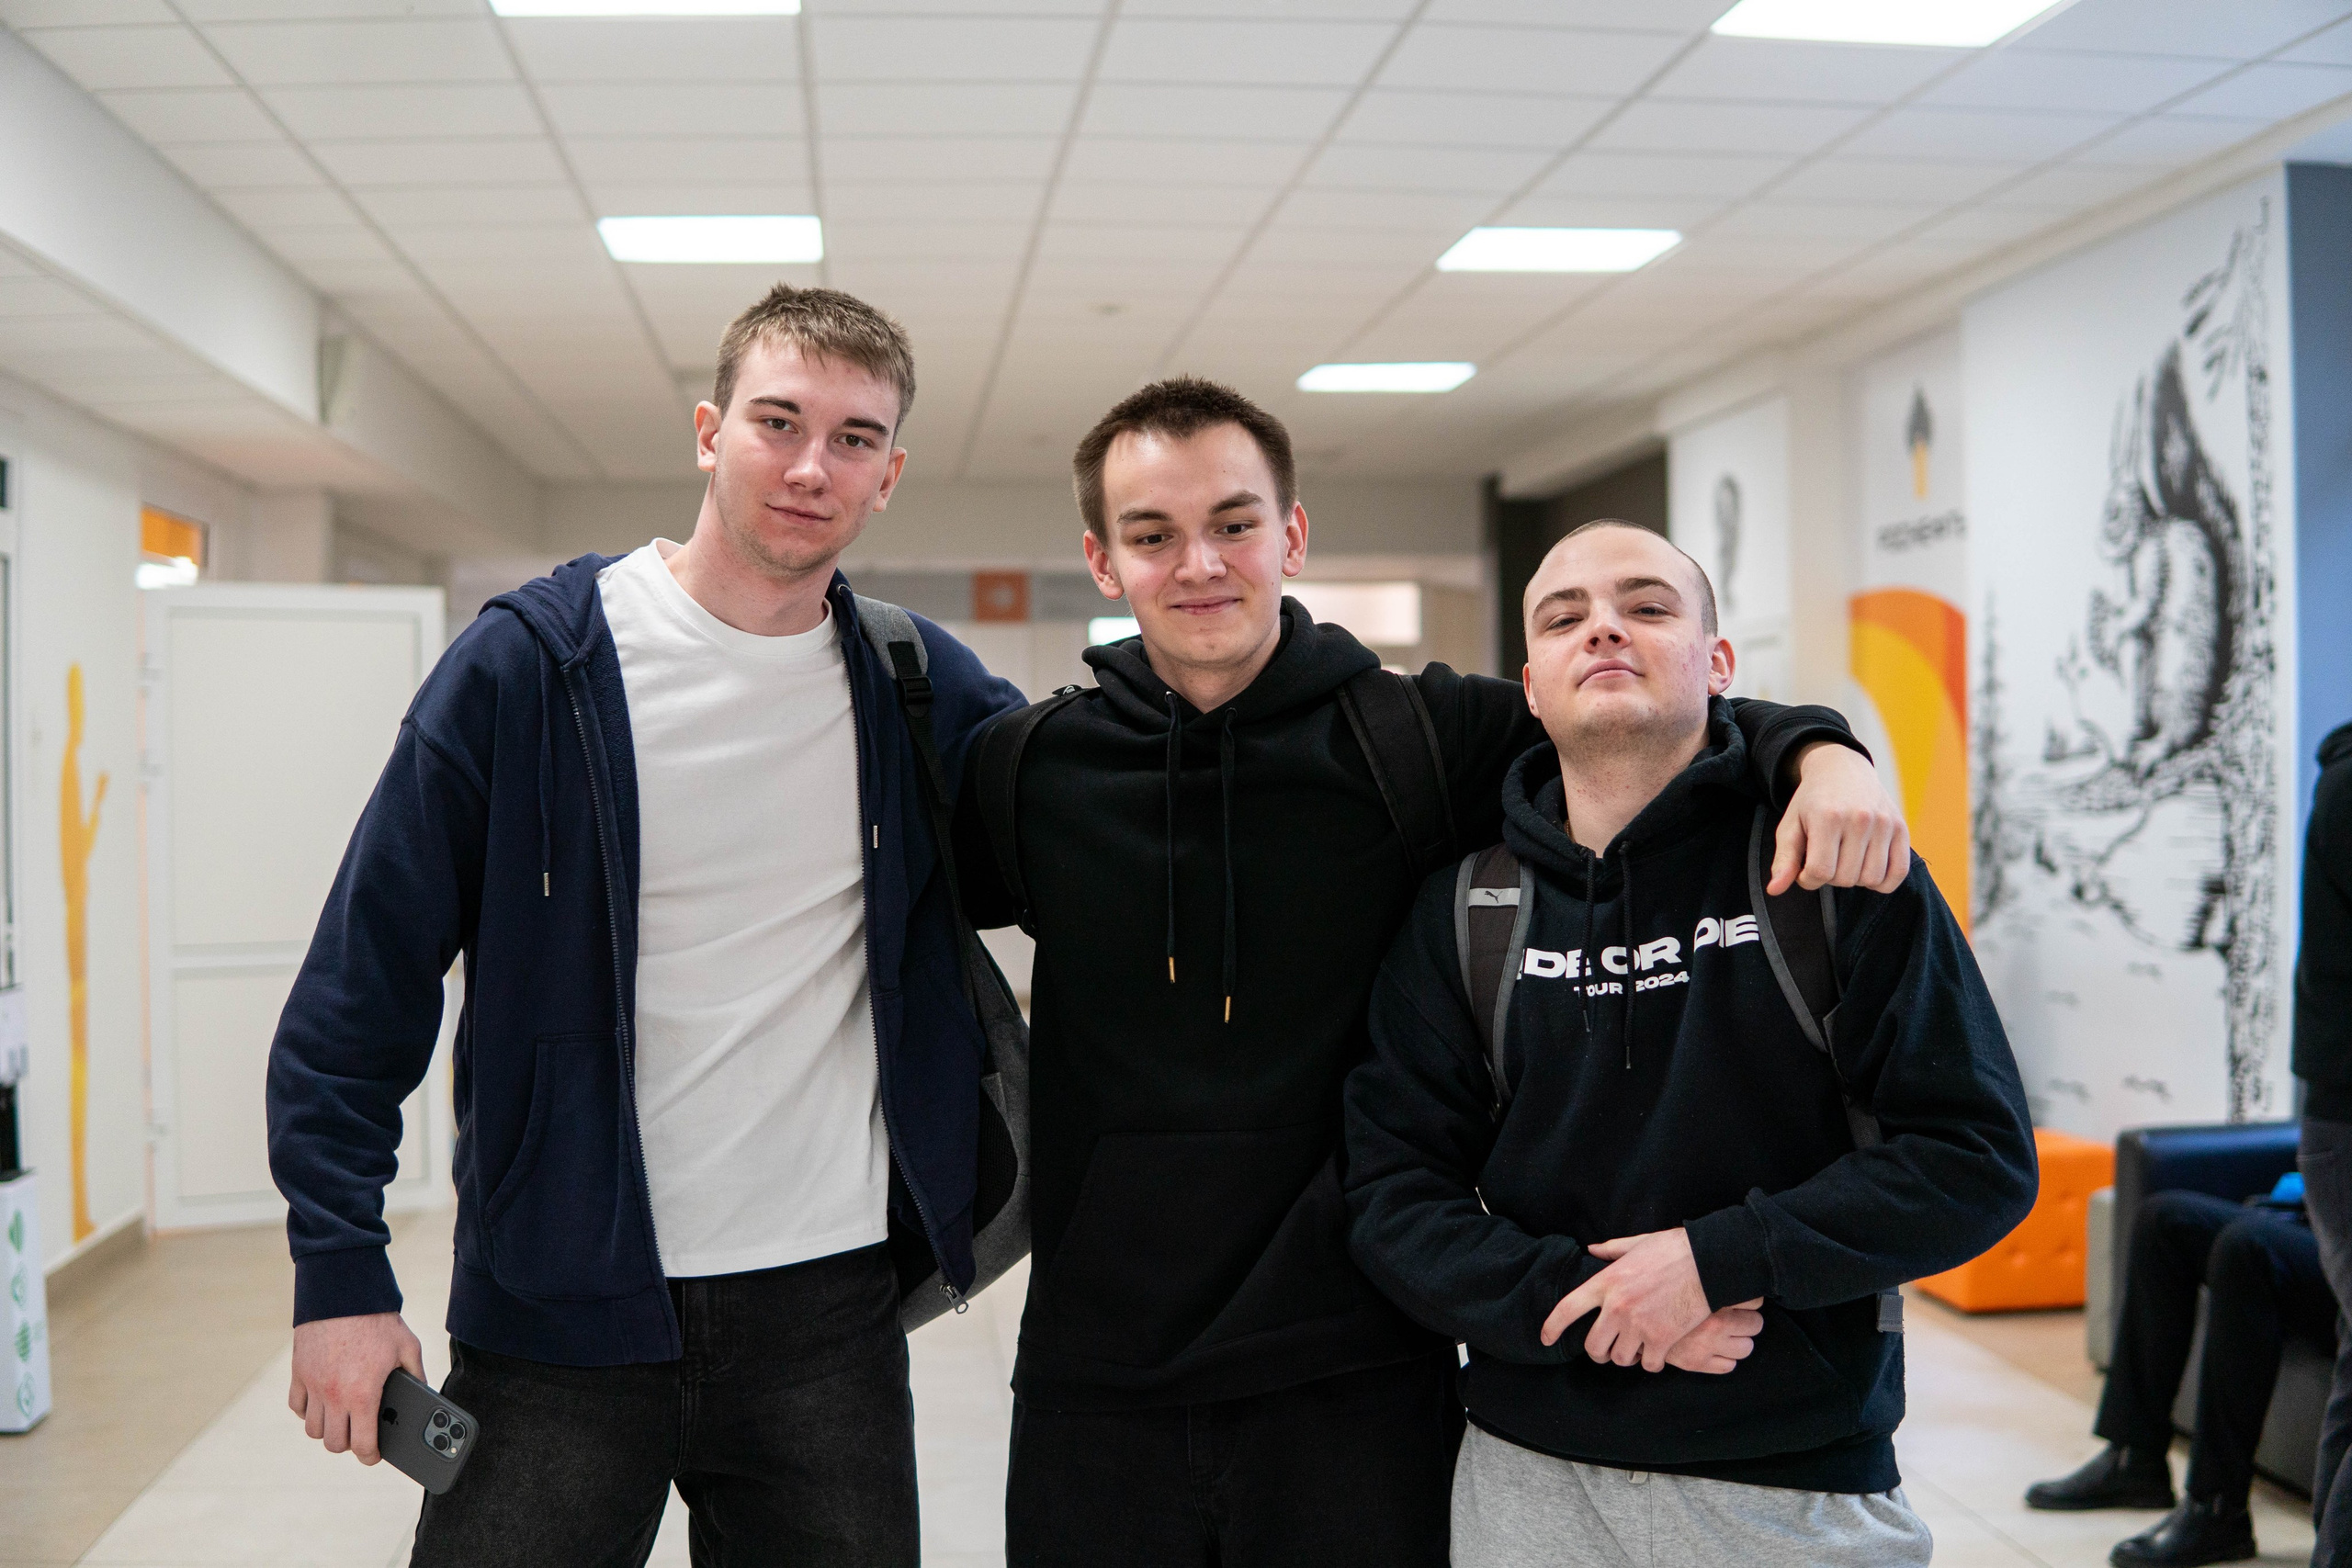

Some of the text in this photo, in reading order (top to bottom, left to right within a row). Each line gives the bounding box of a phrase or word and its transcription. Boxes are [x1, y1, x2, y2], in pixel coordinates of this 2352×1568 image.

[1516, 914, 1759, 980] DE OR DIE
[1635, 970, 1690, 993] 2024
